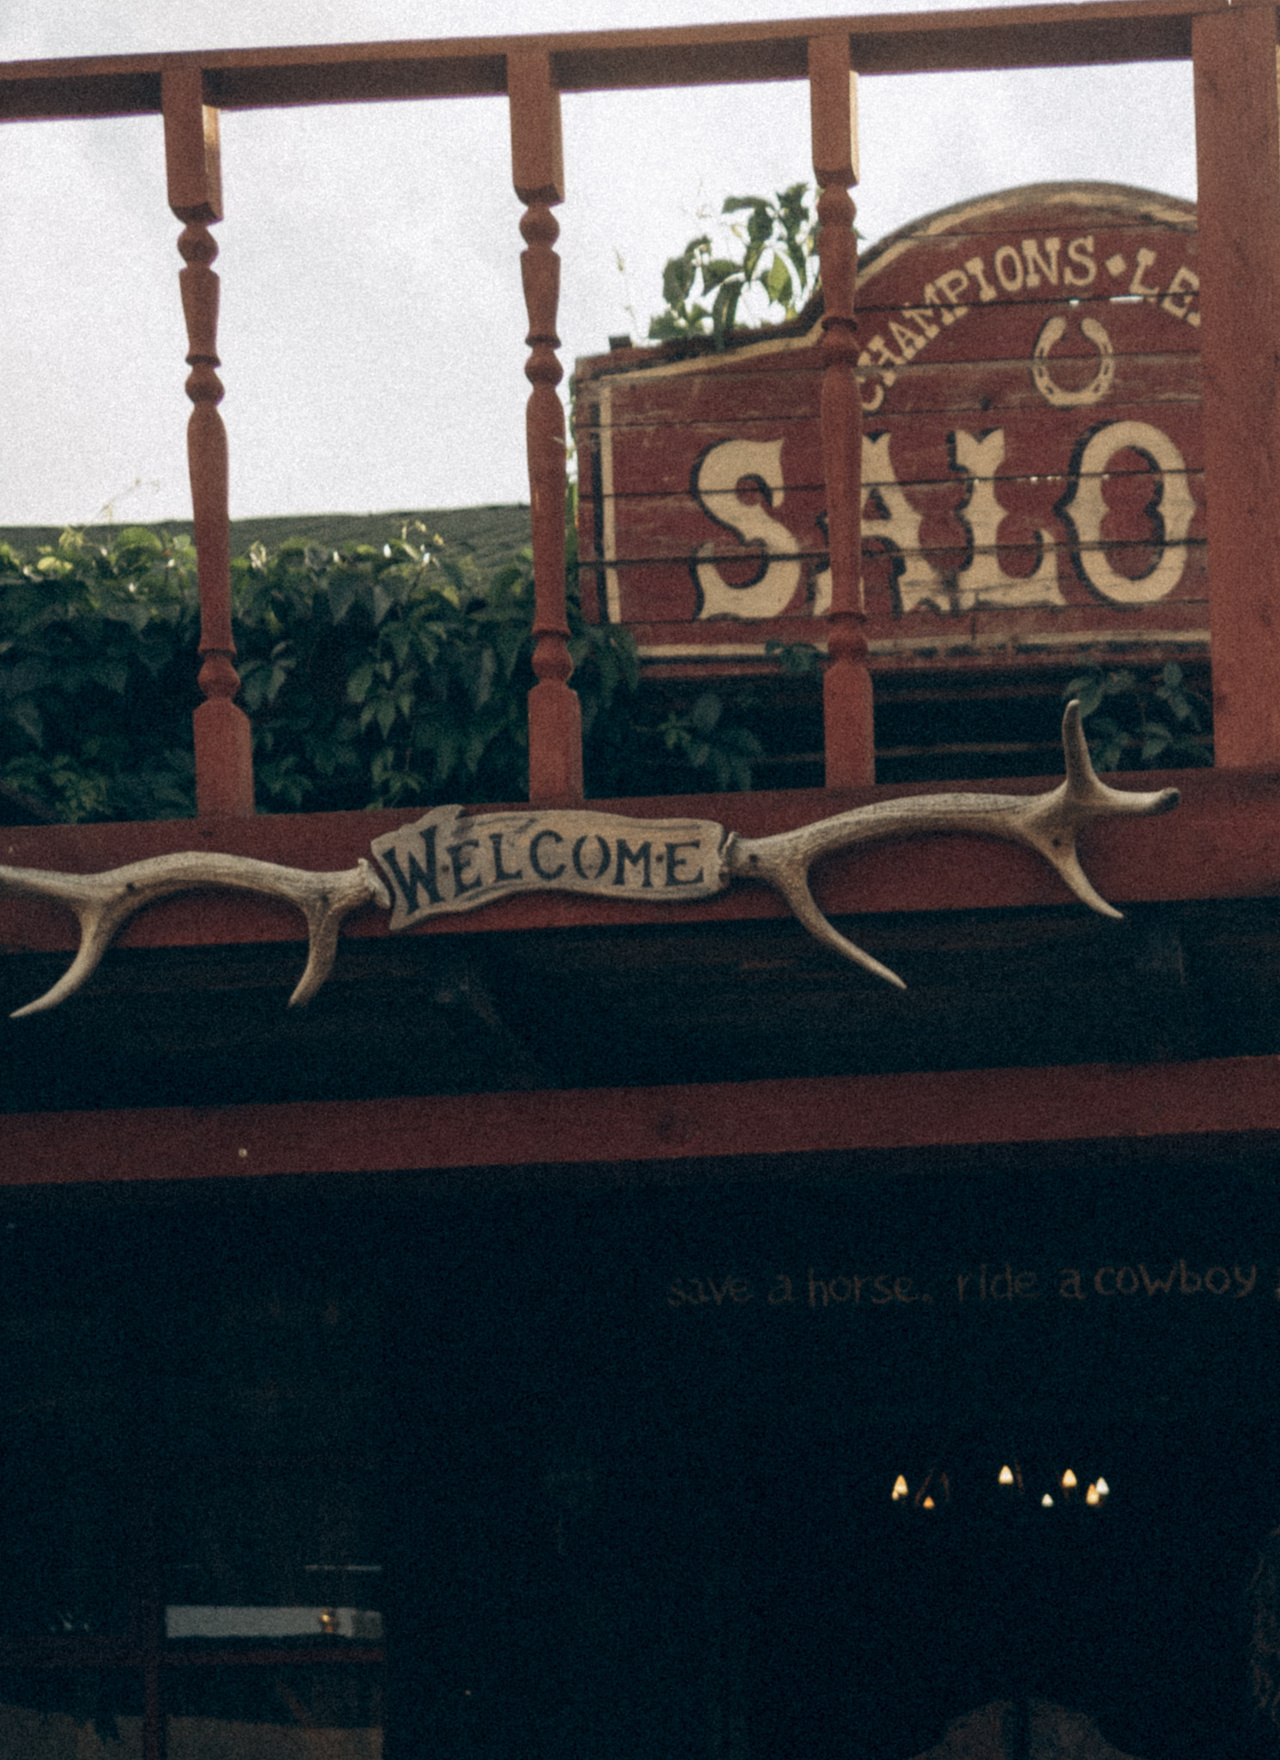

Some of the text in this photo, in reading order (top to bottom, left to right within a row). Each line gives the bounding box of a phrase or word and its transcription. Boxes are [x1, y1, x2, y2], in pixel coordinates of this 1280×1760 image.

[382, 825, 704, 914] WELCOME
[667, 1272, 754, 1307] save
[767, 1273, 795, 1304] a
[956, 1262, 1040, 1304] ride
[1058, 1267, 1086, 1301] a
[1093, 1258, 1257, 1300] cowboy
